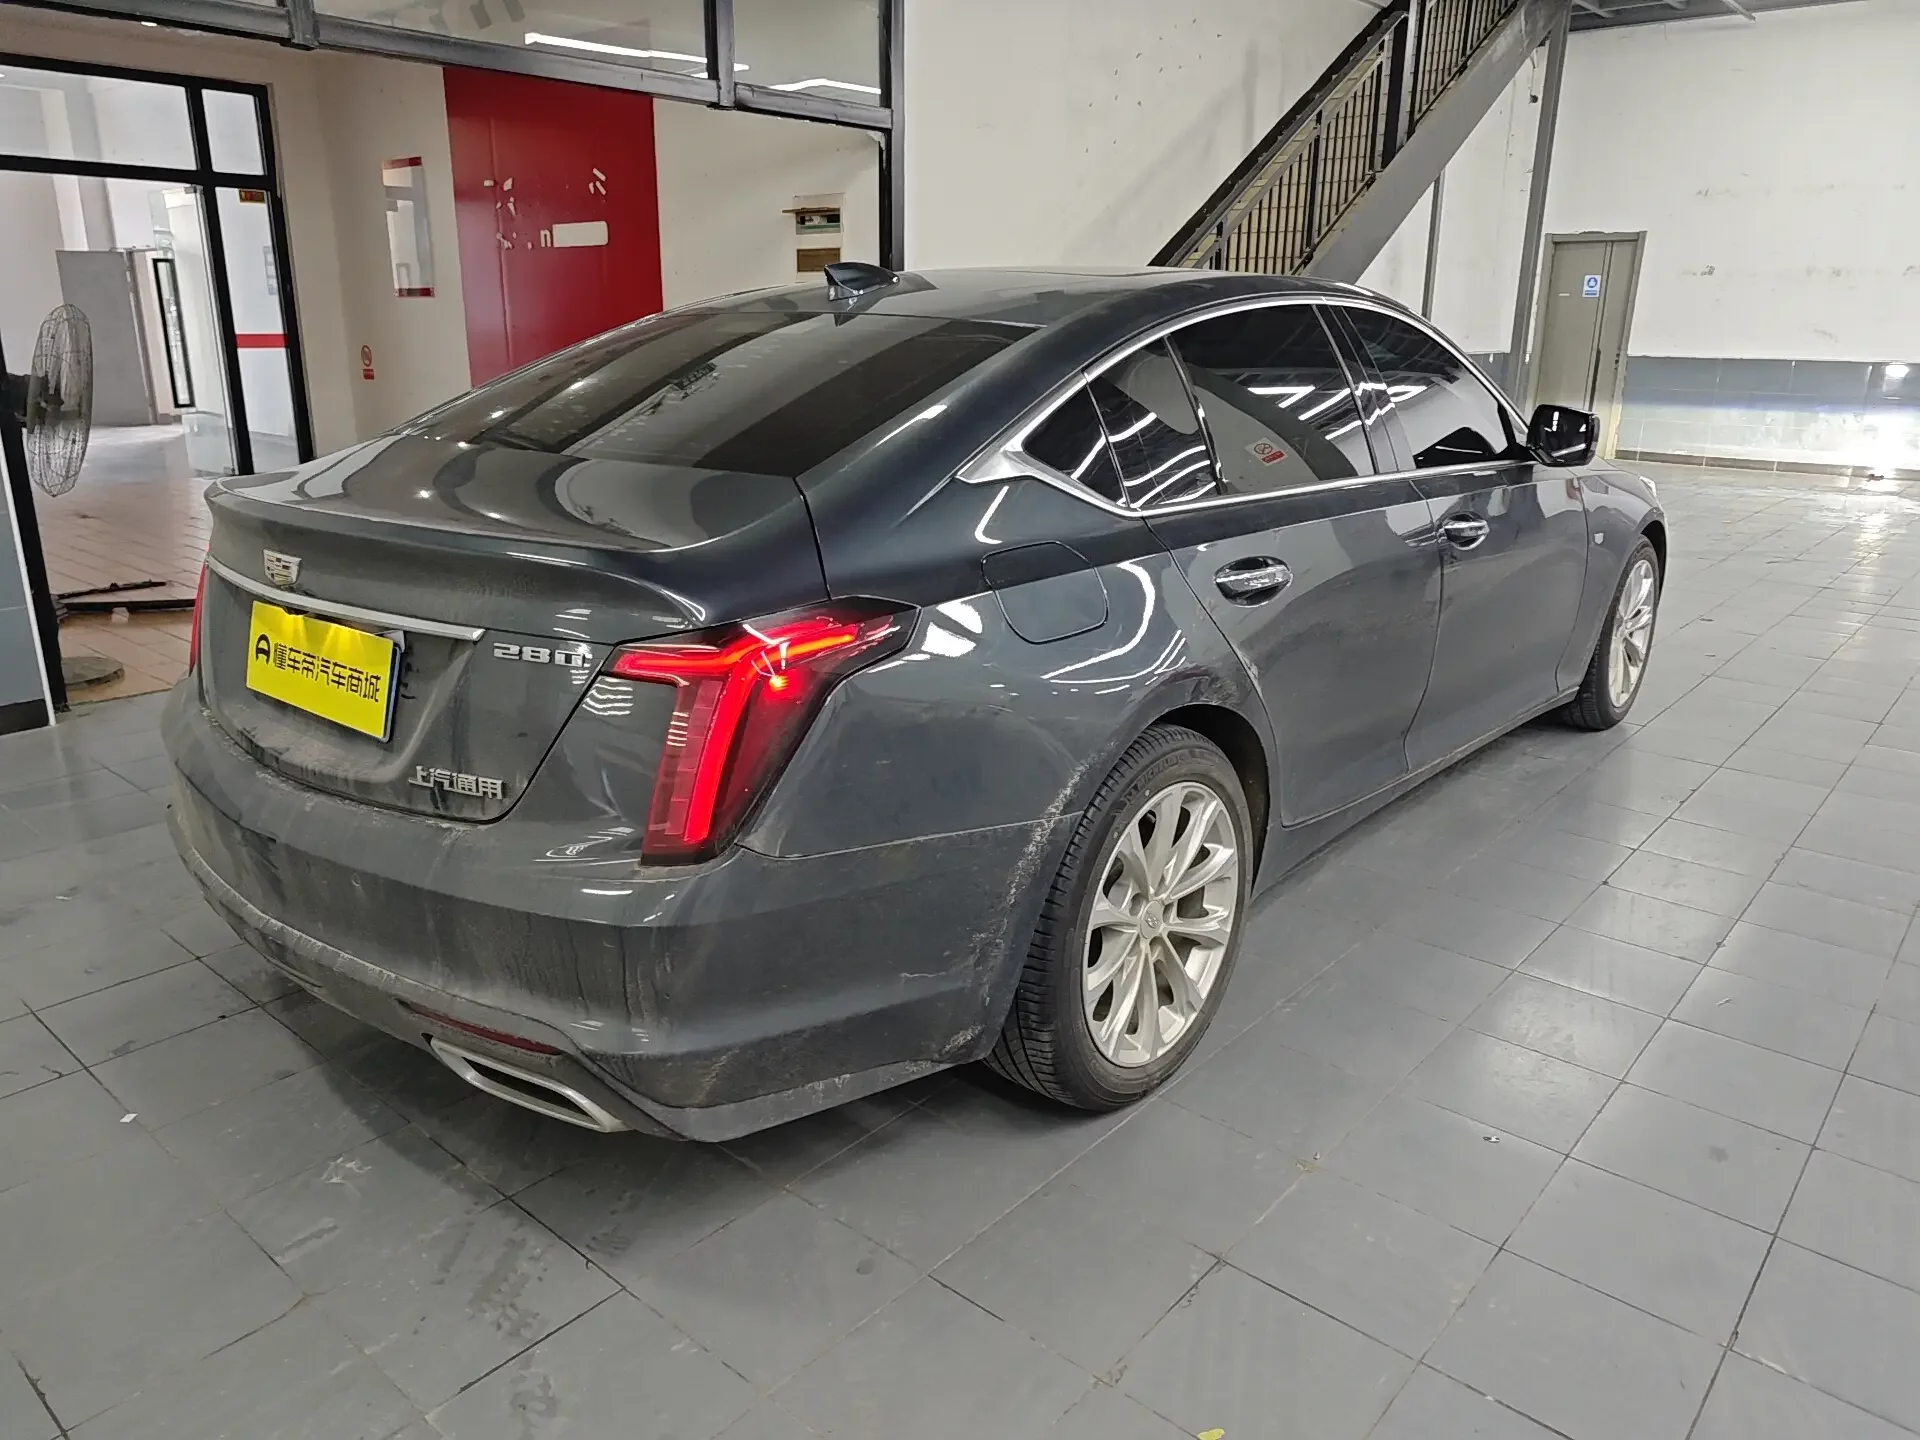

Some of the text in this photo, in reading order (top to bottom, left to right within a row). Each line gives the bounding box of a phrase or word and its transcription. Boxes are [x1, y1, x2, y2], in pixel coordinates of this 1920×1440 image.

[273, 642, 381, 702] 懂车帝汽车商城
[493, 642, 584, 667] 28T
[408, 765, 503, 800] 上汽通用
